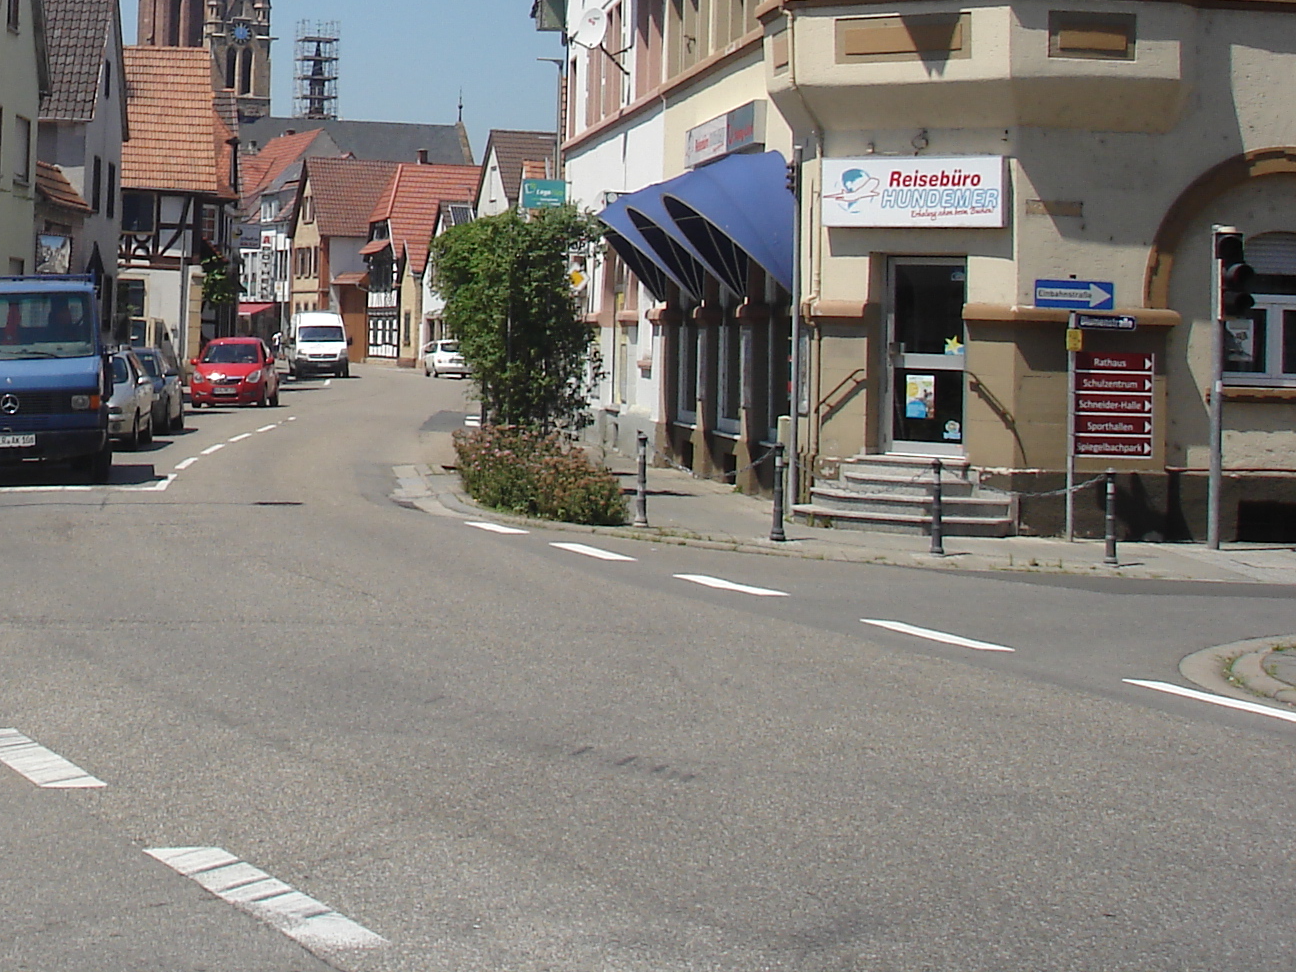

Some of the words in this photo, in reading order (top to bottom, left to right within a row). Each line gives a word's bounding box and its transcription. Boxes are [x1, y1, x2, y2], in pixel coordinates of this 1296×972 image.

[889, 169, 981, 188] Reisebüro
[881, 188, 1000, 209] HUNDEMER
[1038, 289, 1092, 299] Einbahnstraße
[1093, 358, 1127, 367] Rathaus
[1083, 379, 1138, 388] Schulzentrum
[1079, 400, 1142, 410] Schneider-Halle
[1087, 421, 1134, 431] Sporthallen
[1077, 442, 1142, 453] Spiegelbachpark
